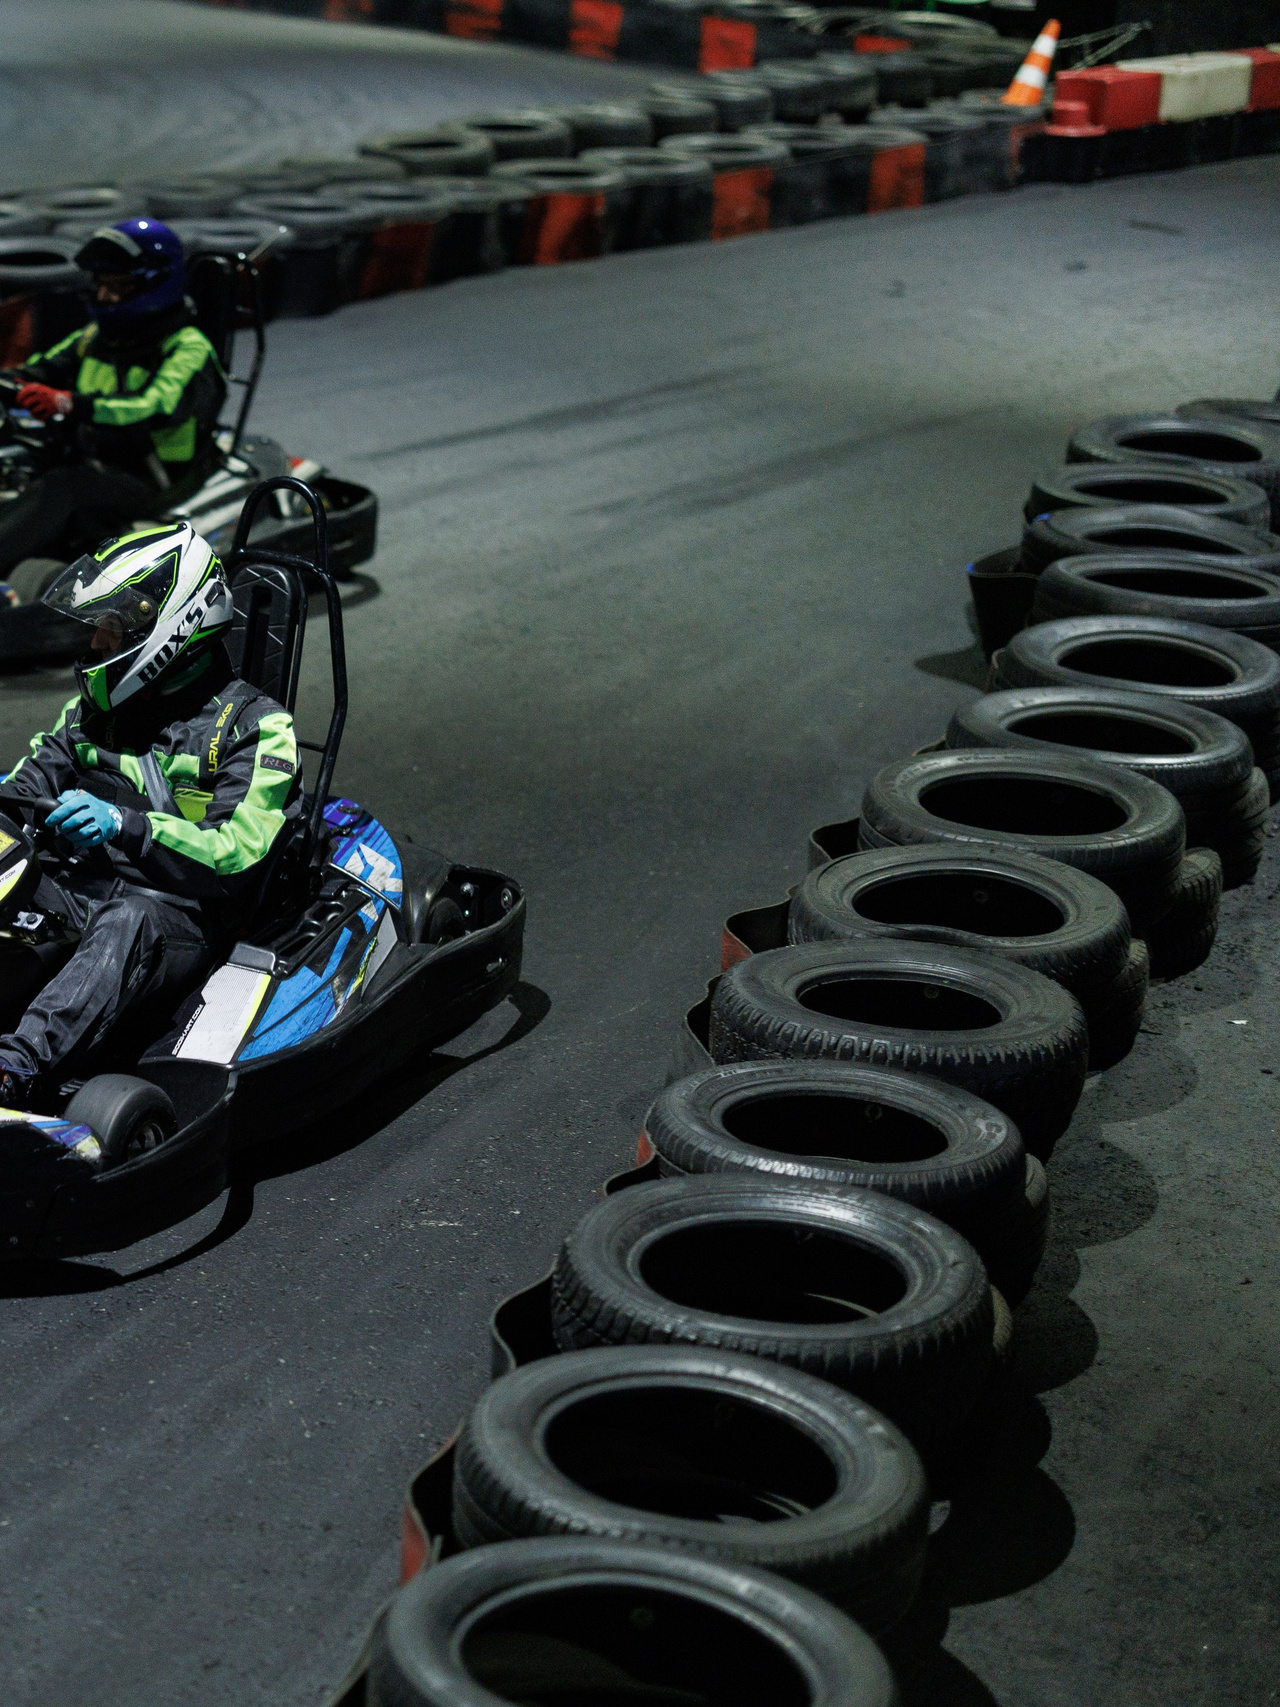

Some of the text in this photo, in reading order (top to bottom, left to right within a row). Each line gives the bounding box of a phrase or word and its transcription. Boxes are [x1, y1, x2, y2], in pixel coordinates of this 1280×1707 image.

[136, 601, 204, 685] BOX'S
[208, 730, 221, 772] URAL
[171, 1003, 204, 1056] SODIKART.COM
